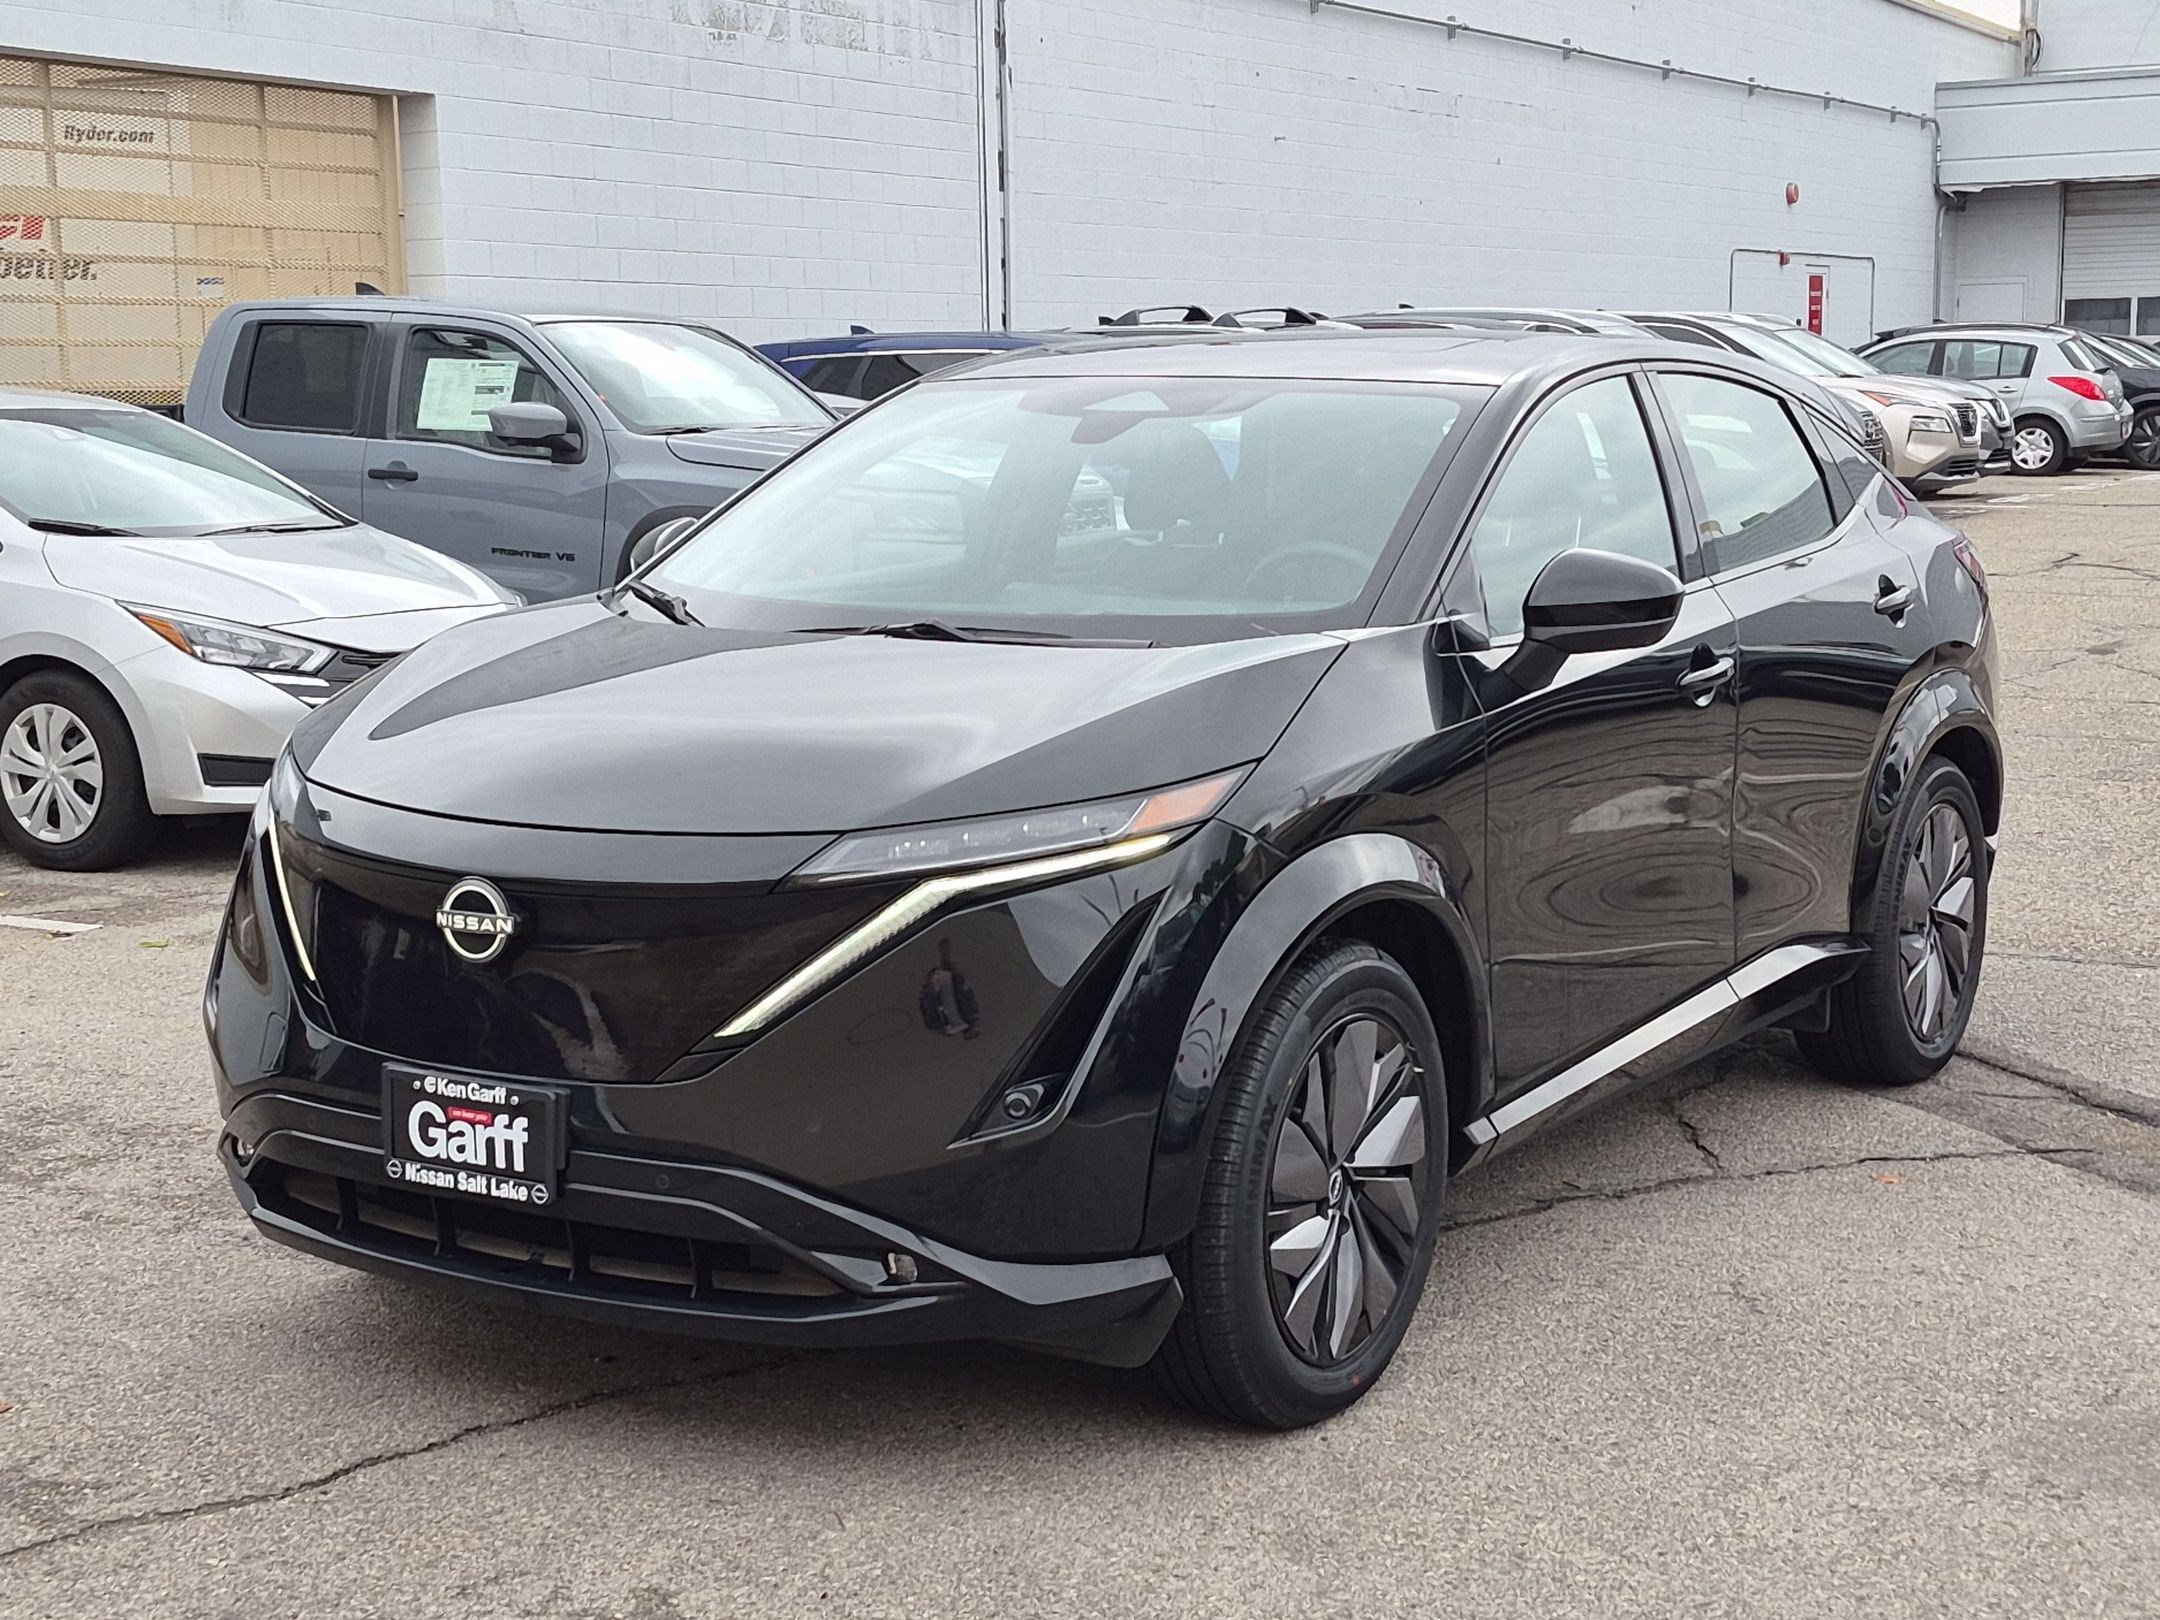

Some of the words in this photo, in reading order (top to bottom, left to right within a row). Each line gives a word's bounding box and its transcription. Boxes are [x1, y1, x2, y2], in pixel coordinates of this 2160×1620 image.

[64, 125, 154, 143] Ryder.com
[491, 547, 551, 560] FRONTIER
[556, 552, 575, 561] V6
[436, 911, 513, 933] NISSAN
[438, 1077, 467, 1099] Ken
[468, 1083, 508, 1105] Garff
[408, 1100, 529, 1173] Garff
[404, 1162, 455, 1188] Nissan
[456, 1171, 488, 1195] Salt
[490, 1178, 529, 1201] Lake
